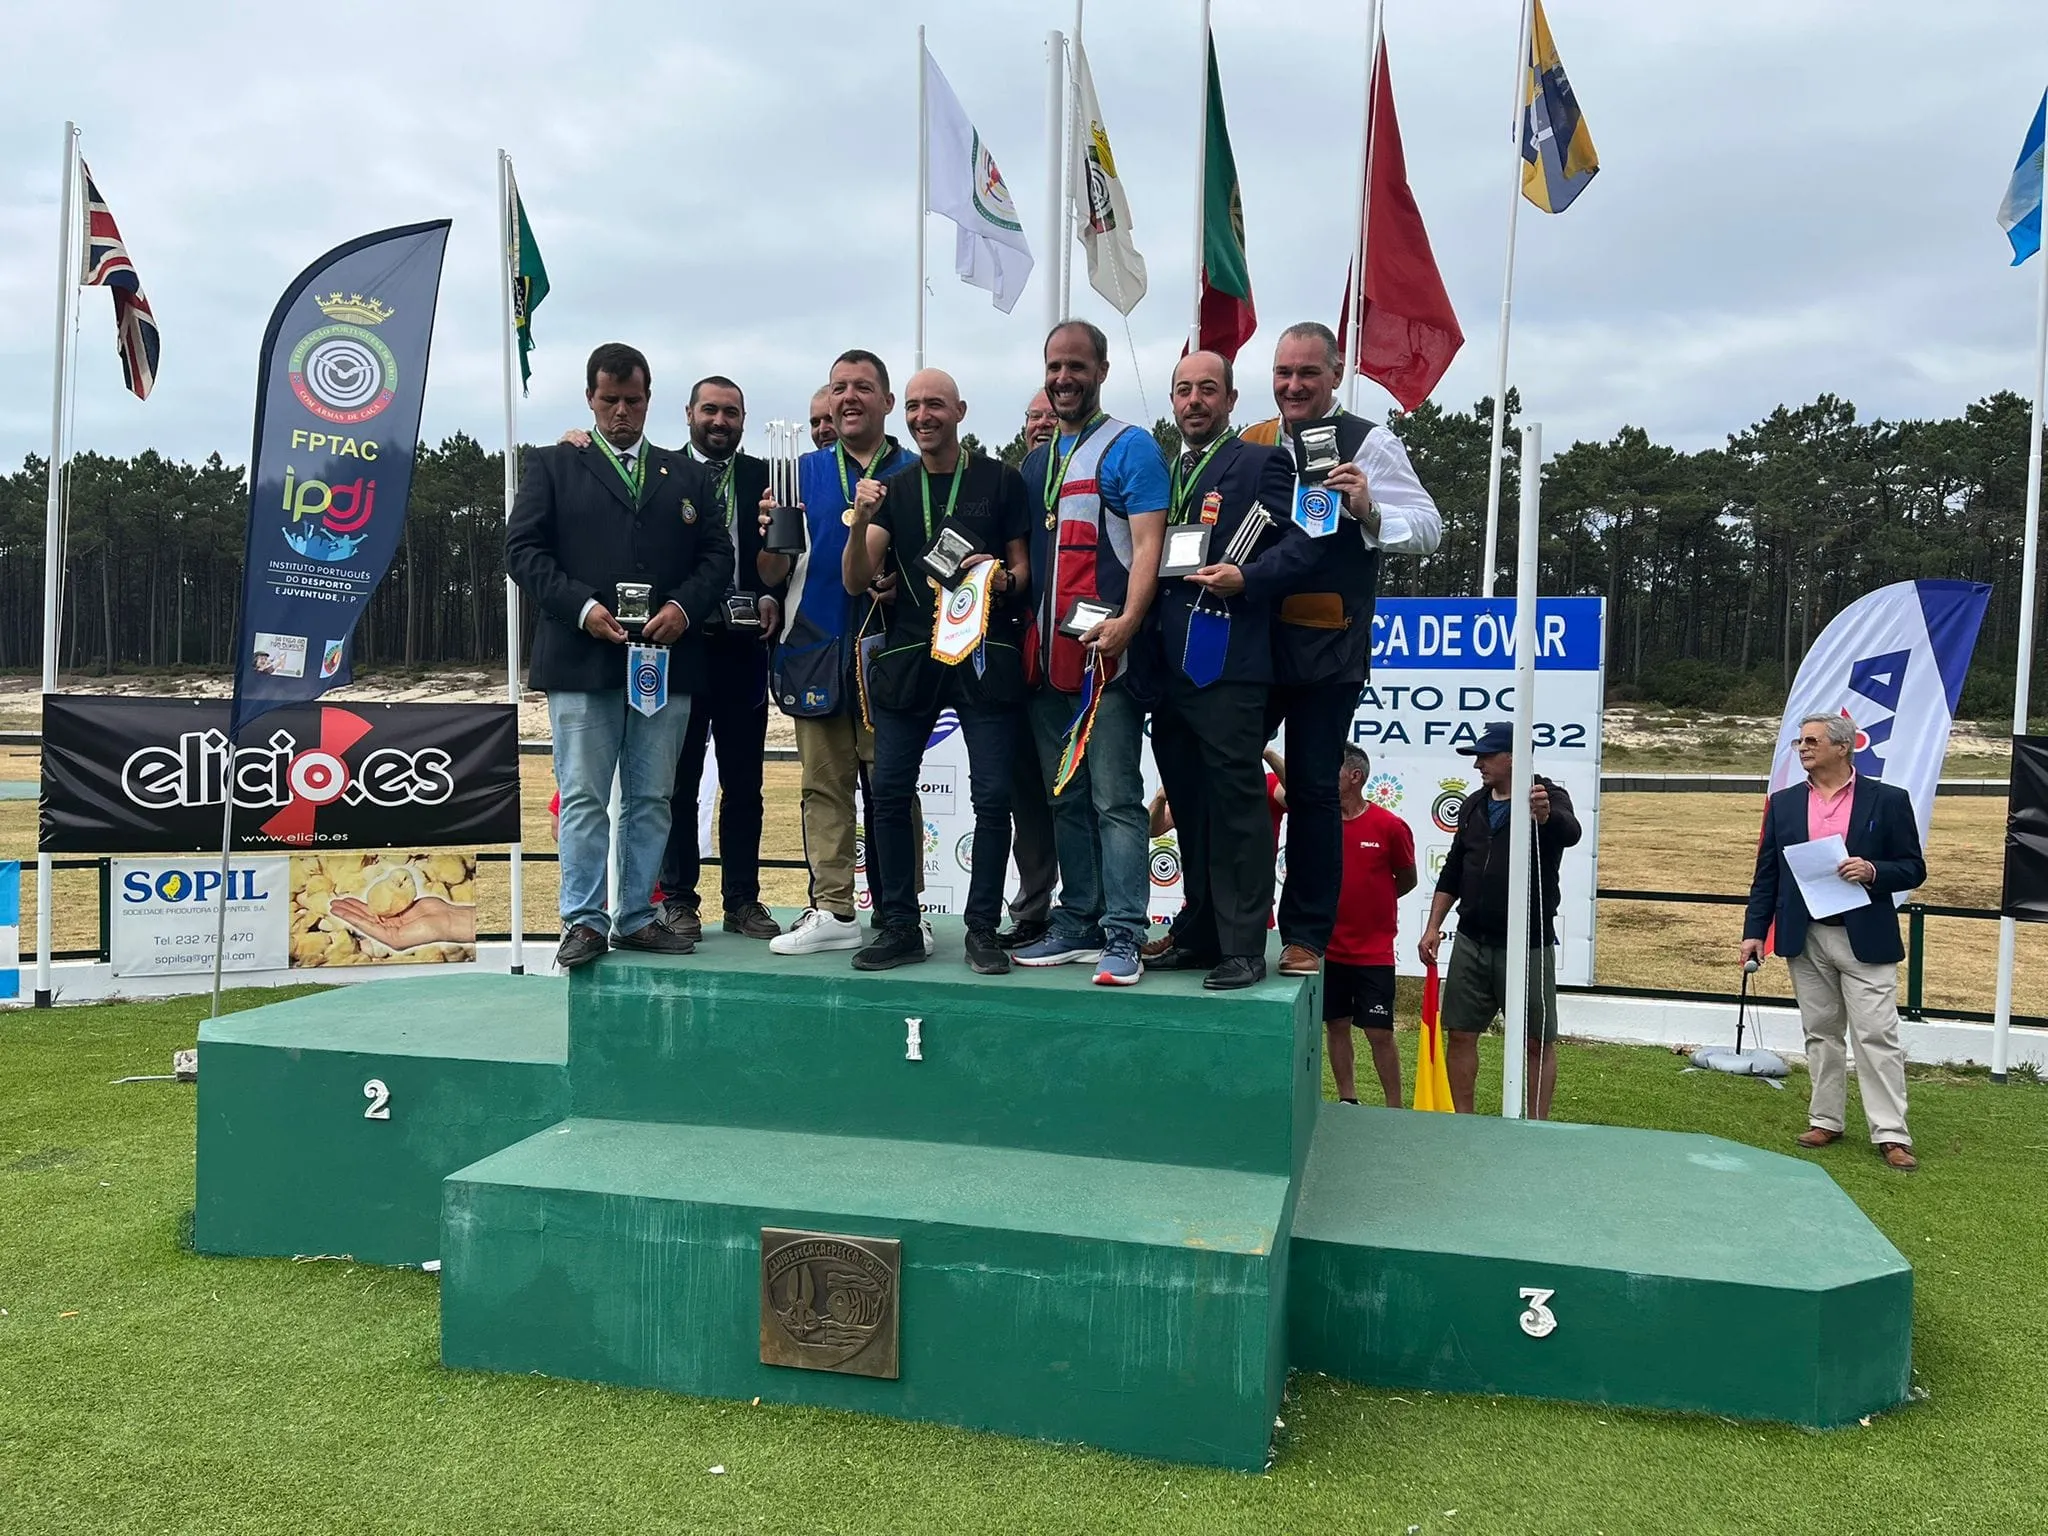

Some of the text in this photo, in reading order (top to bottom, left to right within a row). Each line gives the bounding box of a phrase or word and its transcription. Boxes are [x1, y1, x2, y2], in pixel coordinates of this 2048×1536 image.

[300, 390, 380, 421] COM ARMAS DE CAÇA
[291, 429, 379, 461] FPTAC
[282, 464, 376, 532] ipdj
[269, 560, 371, 580] INSTITUTO PORTUGUÊS
[285, 575, 352, 590] DO DESPORTO
[275, 586, 281, 595] E
[282, 587, 340, 603] JUVENTUDE,
[1371, 614, 1567, 657] CA DE OVR
[1355, 686, 1444, 711] ATO
[1353, 720, 1411, 744] PA
[121, 728, 454, 808] elicio.es
[241, 831, 349, 843] www.elicio.es
[123, 869, 269, 903] SOPIL
[122, 908, 164, 916] SOCIEDADE
[165, 906, 212, 915] PRODUTORA
[920, 904, 950, 914] OPIL
[154, 936, 172, 945] Tel.
[175, 935, 200, 945] 232
[230, 932, 254, 942] 470
[363, 1079, 390, 1120] 2
[768, 1249, 795, 1273] CLUBE
[803, 1243, 827, 1257] CAÇA
[832, 1244, 859, 1263] PESCA
[865, 1260, 890, 1285] OVAR
[1519, 1287, 1558, 1338] 3
